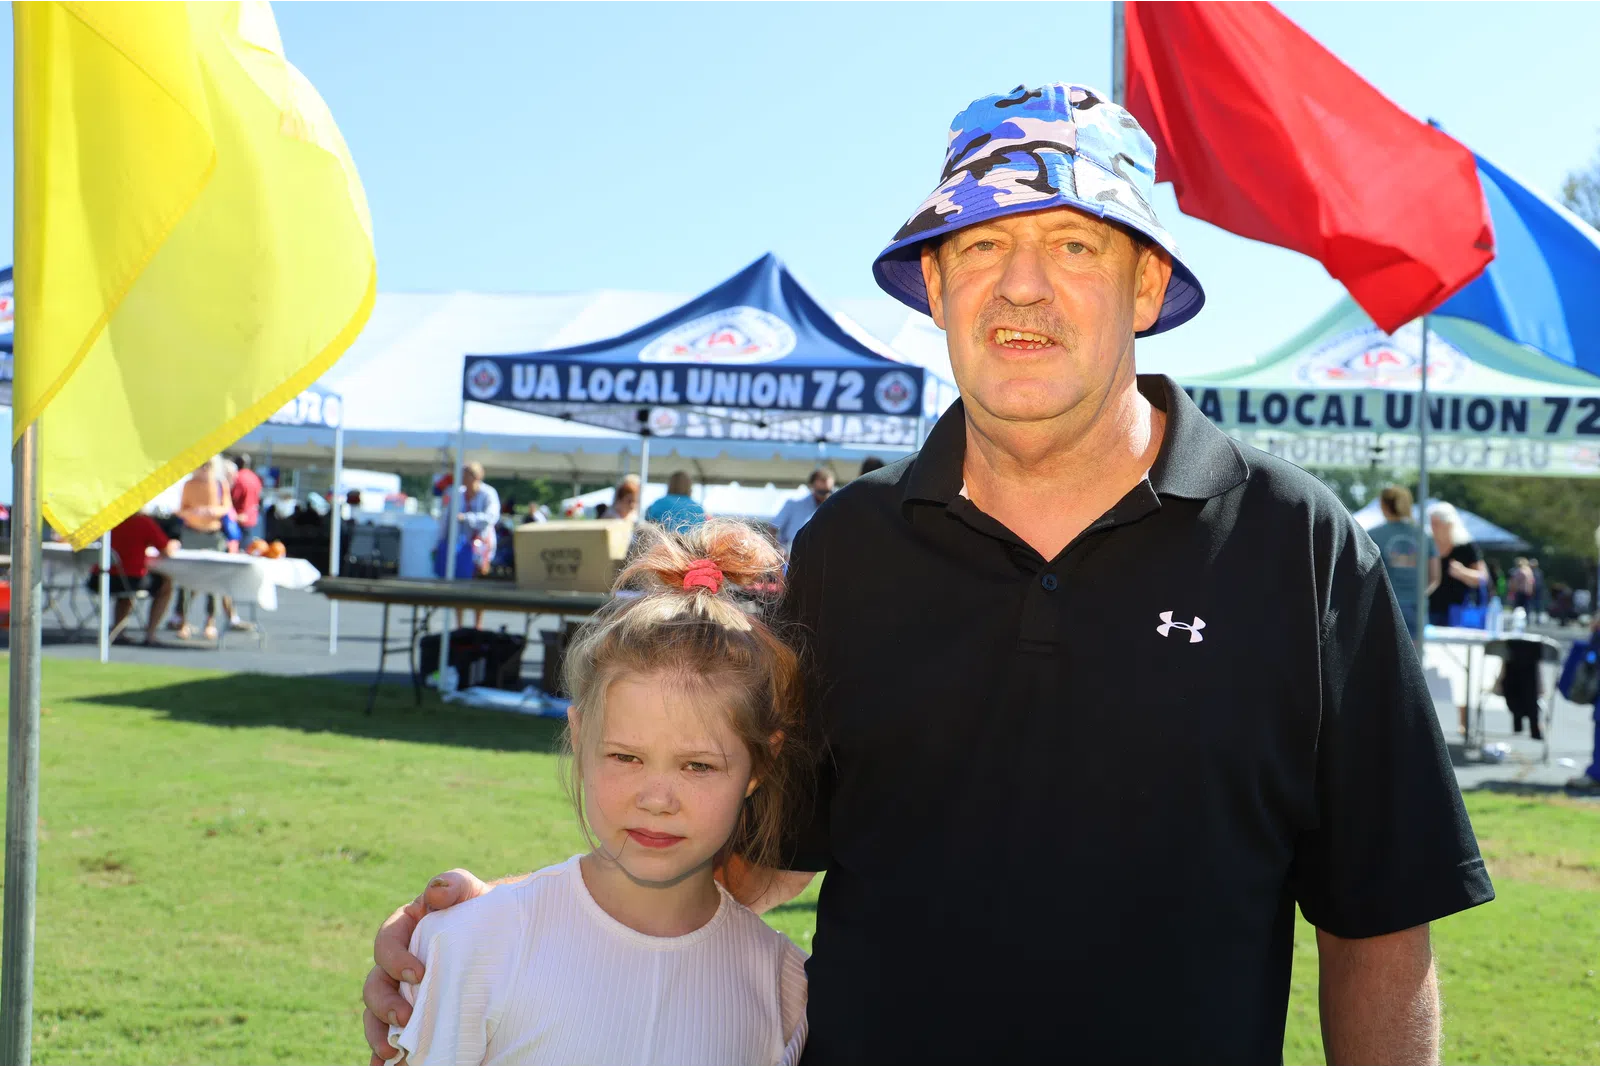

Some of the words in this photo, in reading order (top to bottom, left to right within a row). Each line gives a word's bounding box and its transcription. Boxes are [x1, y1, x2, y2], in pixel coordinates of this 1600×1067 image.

[511, 364, 560, 400] UA
[568, 365, 679, 403] LOCAL
[686, 368, 804, 409] UNION
[812, 370, 865, 411] 72
[1238, 389, 1373, 428] LOCAL
[1385, 393, 1528, 433] UNION
[1544, 397, 1600, 435] 72
